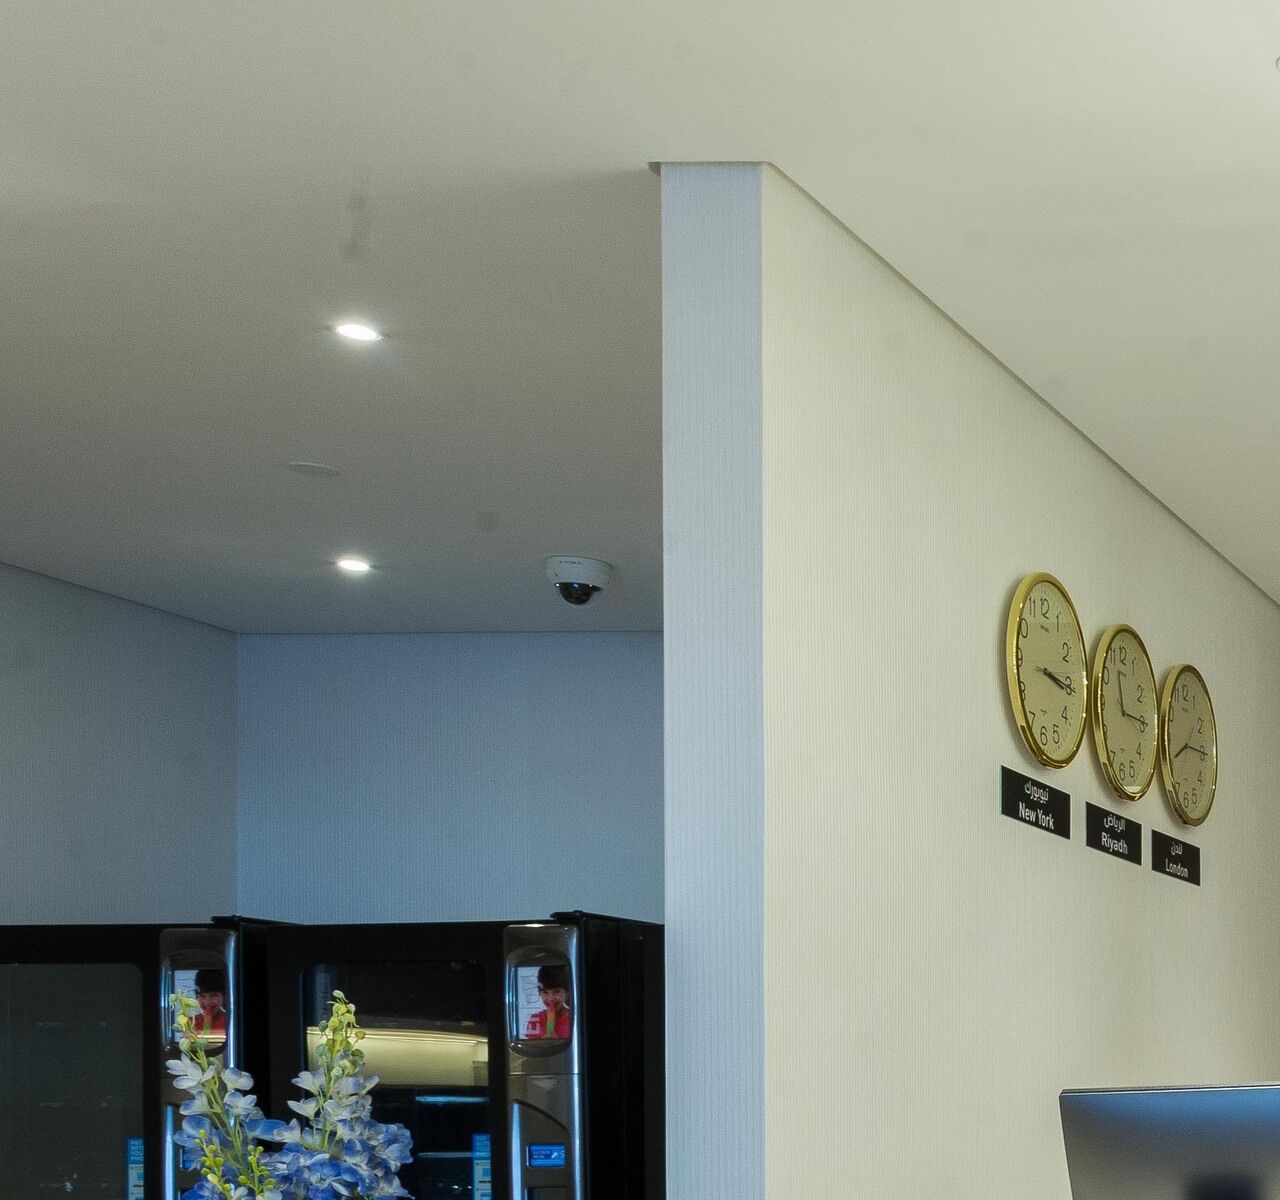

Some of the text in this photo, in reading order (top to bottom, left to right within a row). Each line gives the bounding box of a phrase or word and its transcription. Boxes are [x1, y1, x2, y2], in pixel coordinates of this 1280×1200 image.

[1028, 596, 1036, 618] 11
[1040, 597, 1050, 620] 12
[1020, 618, 1029, 639] 0
[1062, 642, 1070, 663] 2
[1110, 647, 1116, 665] 11
[1119, 645, 1127, 665] 12
[1136, 684, 1143, 703] 2
[1182, 684, 1189, 702] 12
[1061, 705, 1069, 724] 4
[1039, 725, 1048, 746] 6
[1052, 724, 1060, 744] 5
[1118, 762, 1126, 781] 6
[1129, 760, 1136, 779] 5
[1018, 801, 1055, 830] New York
[1103, 814, 1126, 832] الرياض
[1101, 832, 1128, 855] Riyadh
[1170, 841, 1183, 856] لندن
[1165, 858, 1189, 878] London
